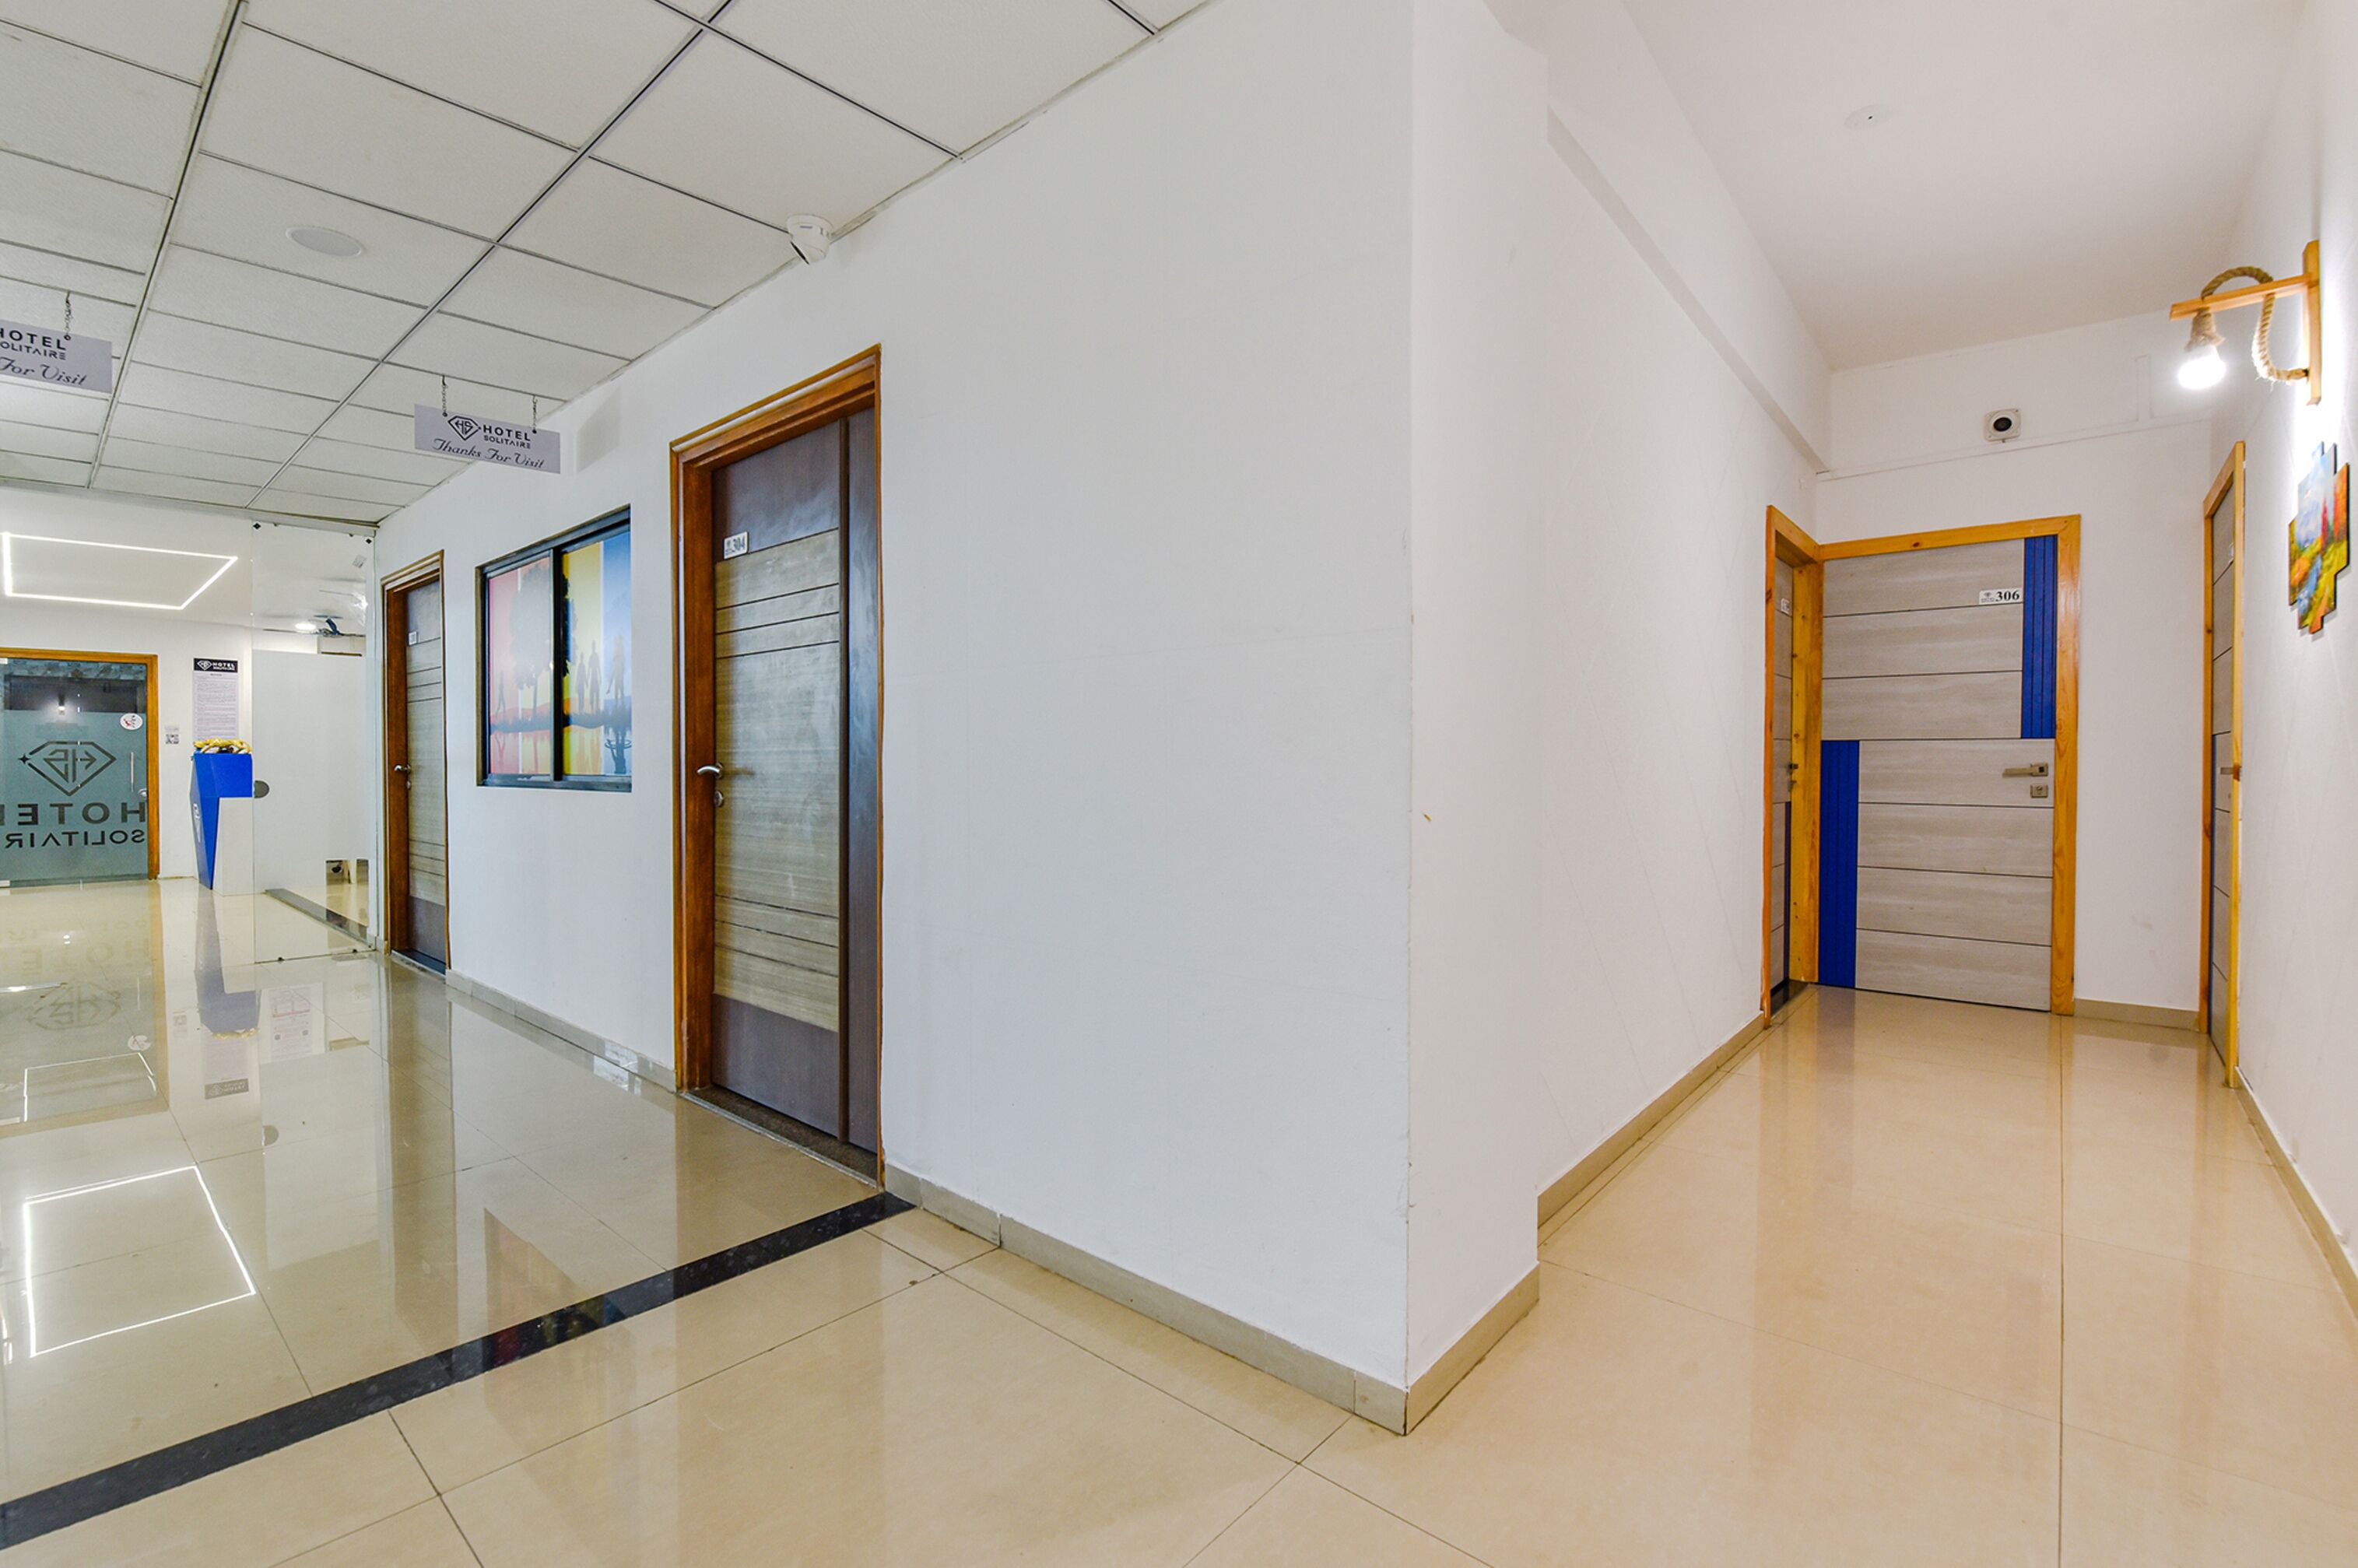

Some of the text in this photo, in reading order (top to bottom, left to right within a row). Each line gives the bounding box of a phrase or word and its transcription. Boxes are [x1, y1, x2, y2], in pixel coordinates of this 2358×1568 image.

[40, 363, 87, 385] Visit
[483, 424, 531, 442] HOTEL
[483, 435, 531, 449] SOLITAIRE
[432, 438, 545, 468] Thanks For Visit
[1995, 591, 2019, 602] 306
